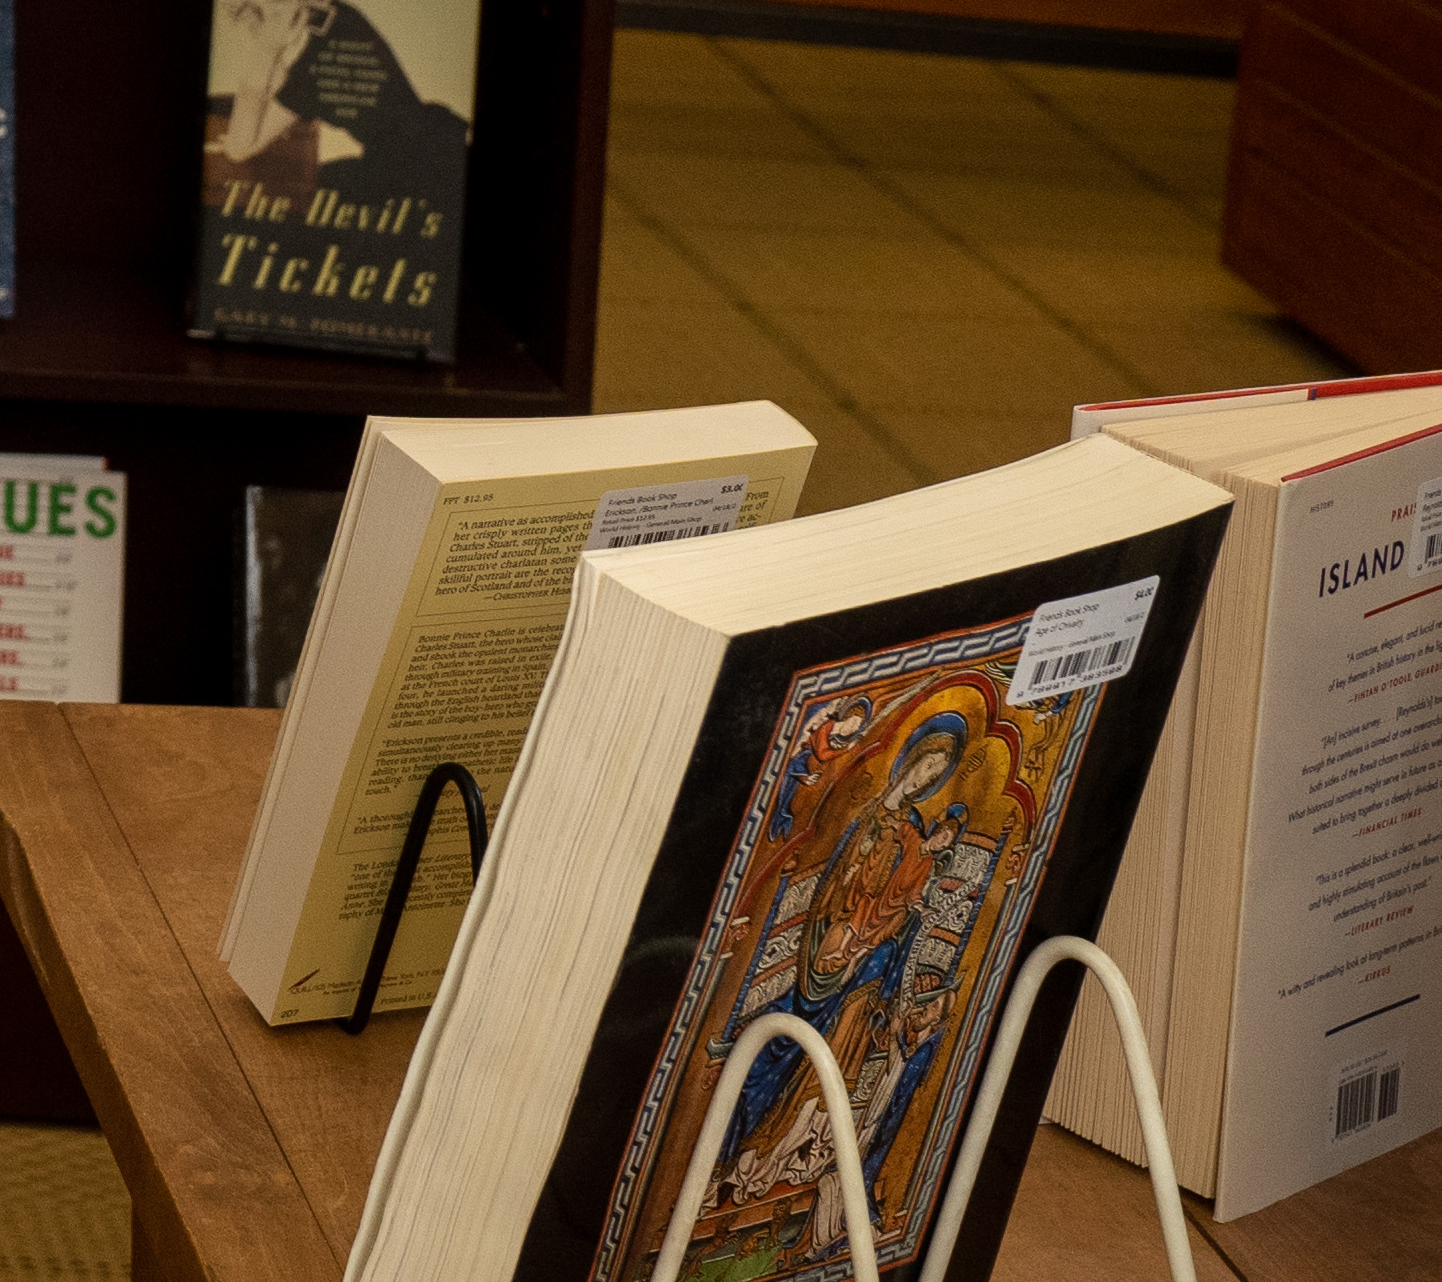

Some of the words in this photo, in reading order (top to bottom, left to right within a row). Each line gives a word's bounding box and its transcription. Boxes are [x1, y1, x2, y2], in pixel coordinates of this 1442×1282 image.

[220, 180, 293, 224] The
[305, 188, 444, 239] Devil's
[216, 234, 440, 307] Tickets
[607, 495, 635, 507] Friends
[1309, 499, 1334, 513] HISTORY
[1318, 540, 1405, 598] ISLAND
